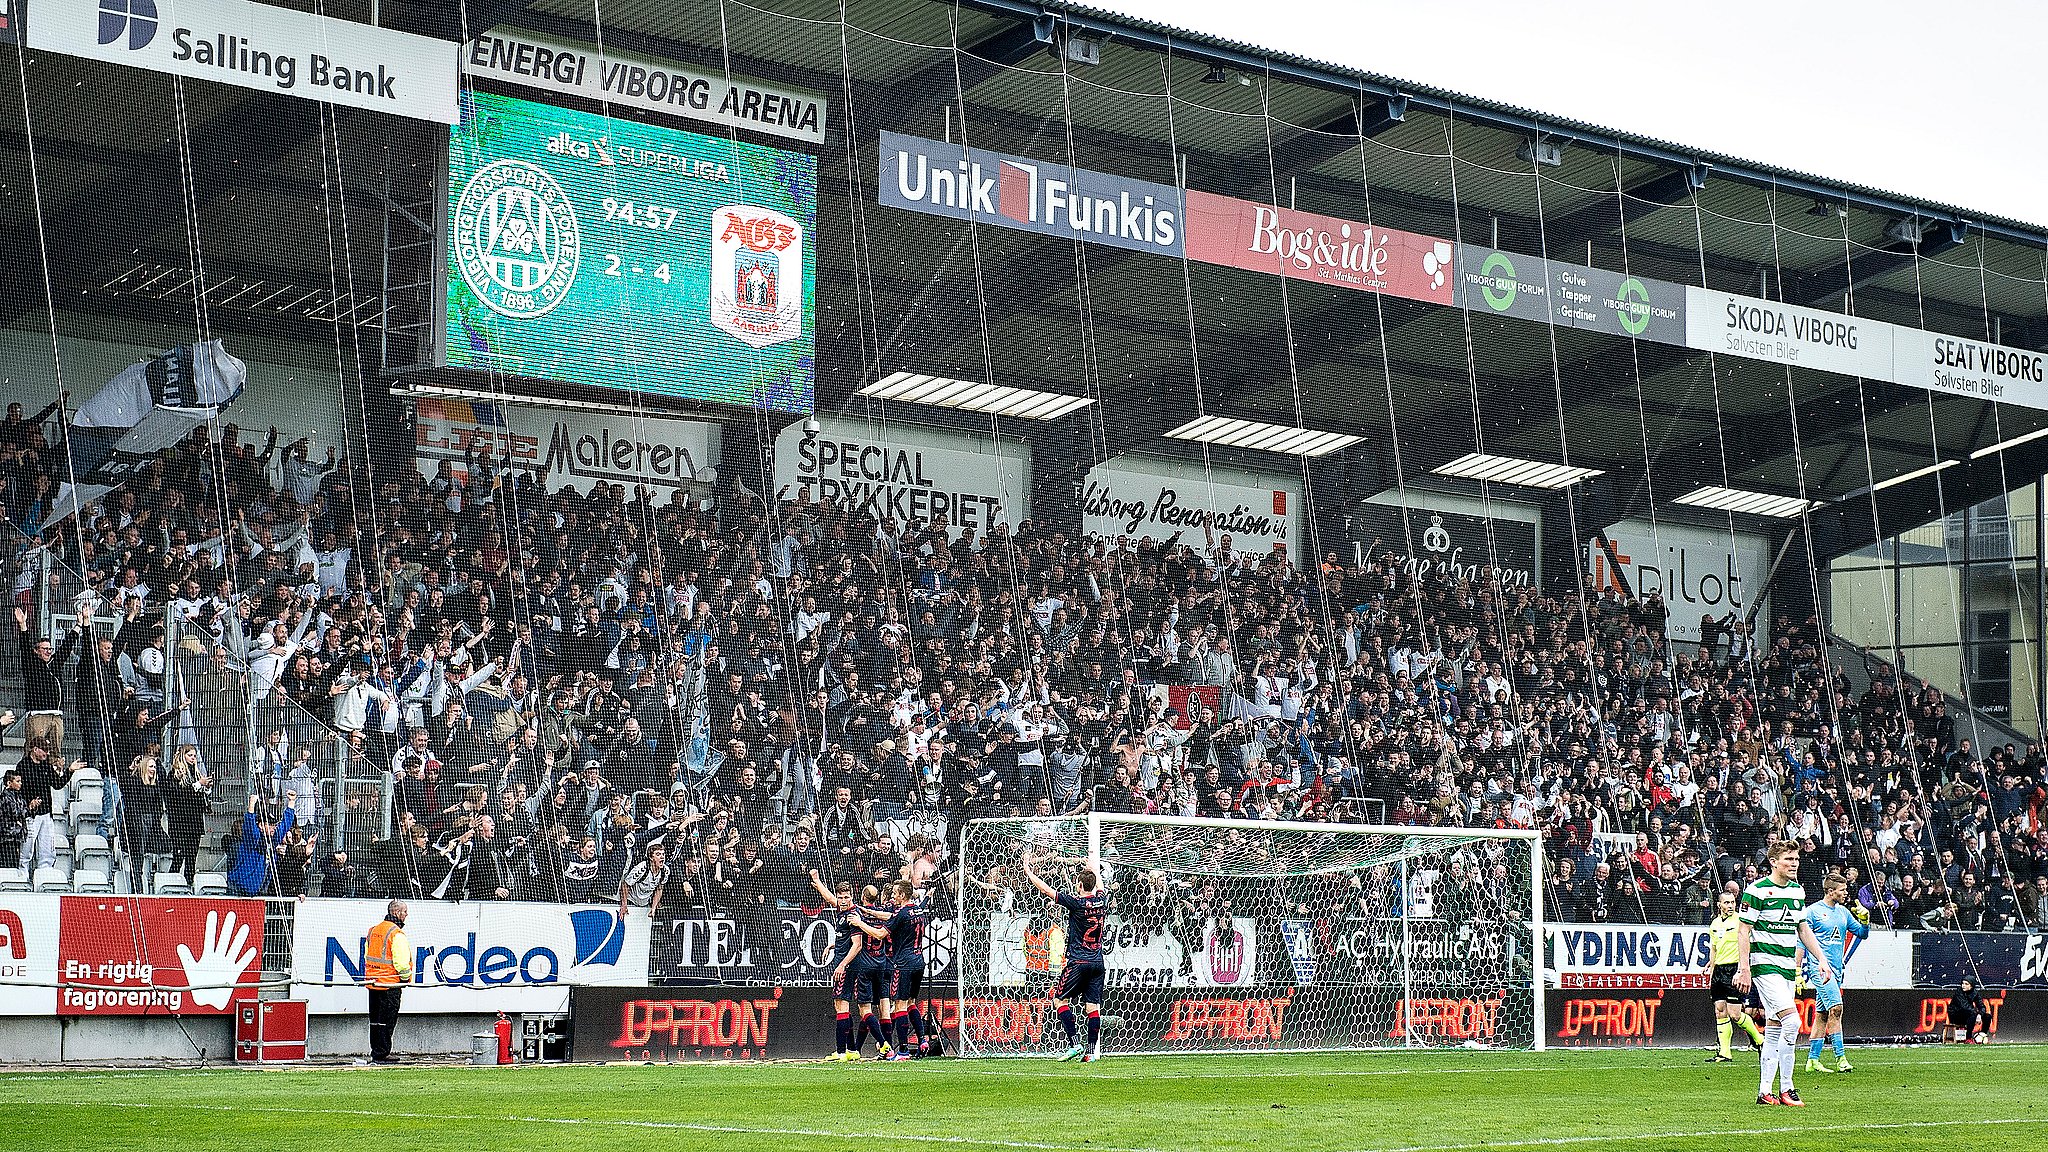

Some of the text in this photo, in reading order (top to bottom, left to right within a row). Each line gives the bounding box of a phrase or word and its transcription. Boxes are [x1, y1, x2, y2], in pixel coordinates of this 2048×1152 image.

[172, 28, 397, 100] Salling Bank
[470, 35, 820, 133] ENERGI VIBORG ARENA
[547, 132, 730, 183] alka SUPERLIGA
[602, 198, 678, 230] 94:57
[898, 150, 1176, 245] Unik Funkis
[1248, 205, 1388, 275] Bog&idé
[604, 253, 621, 276] 2
[653, 262, 671, 284] 4
[1465, 272, 1544, 296] VIBORG GULV FORUM
[1561, 271, 1586, 287] Gulve
[1561, 304, 1597, 322] Gardiner
[1603, 298, 1630, 312] VIBORG
[1651, 307, 1676, 320] FORUM
[1726, 298, 1858, 350] ŠKODA VIBORG
[1726, 333, 1799, 361] Sølvsten Biler
[1934, 337, 2043, 383] SEAT VIBORG
[1934, 370, 2004, 397] Sølvsten Biler
[546, 421, 698, 480] Maleren
[797, 437, 933, 487] SPECIAL
[325, 932, 559, 985] Nrdea
[1562, 930, 1711, 971] YDING A/S
[2, 966, 26, 976] DE
[65, 960, 153, 983] En rigtig
[1565, 975, 1644, 988] TOTALBYG
[64, 990, 182, 1011] fagforening
[1565, 998, 1661, 1037] UPFRONT
[626, 1000, 779, 1045] UPFRONT
